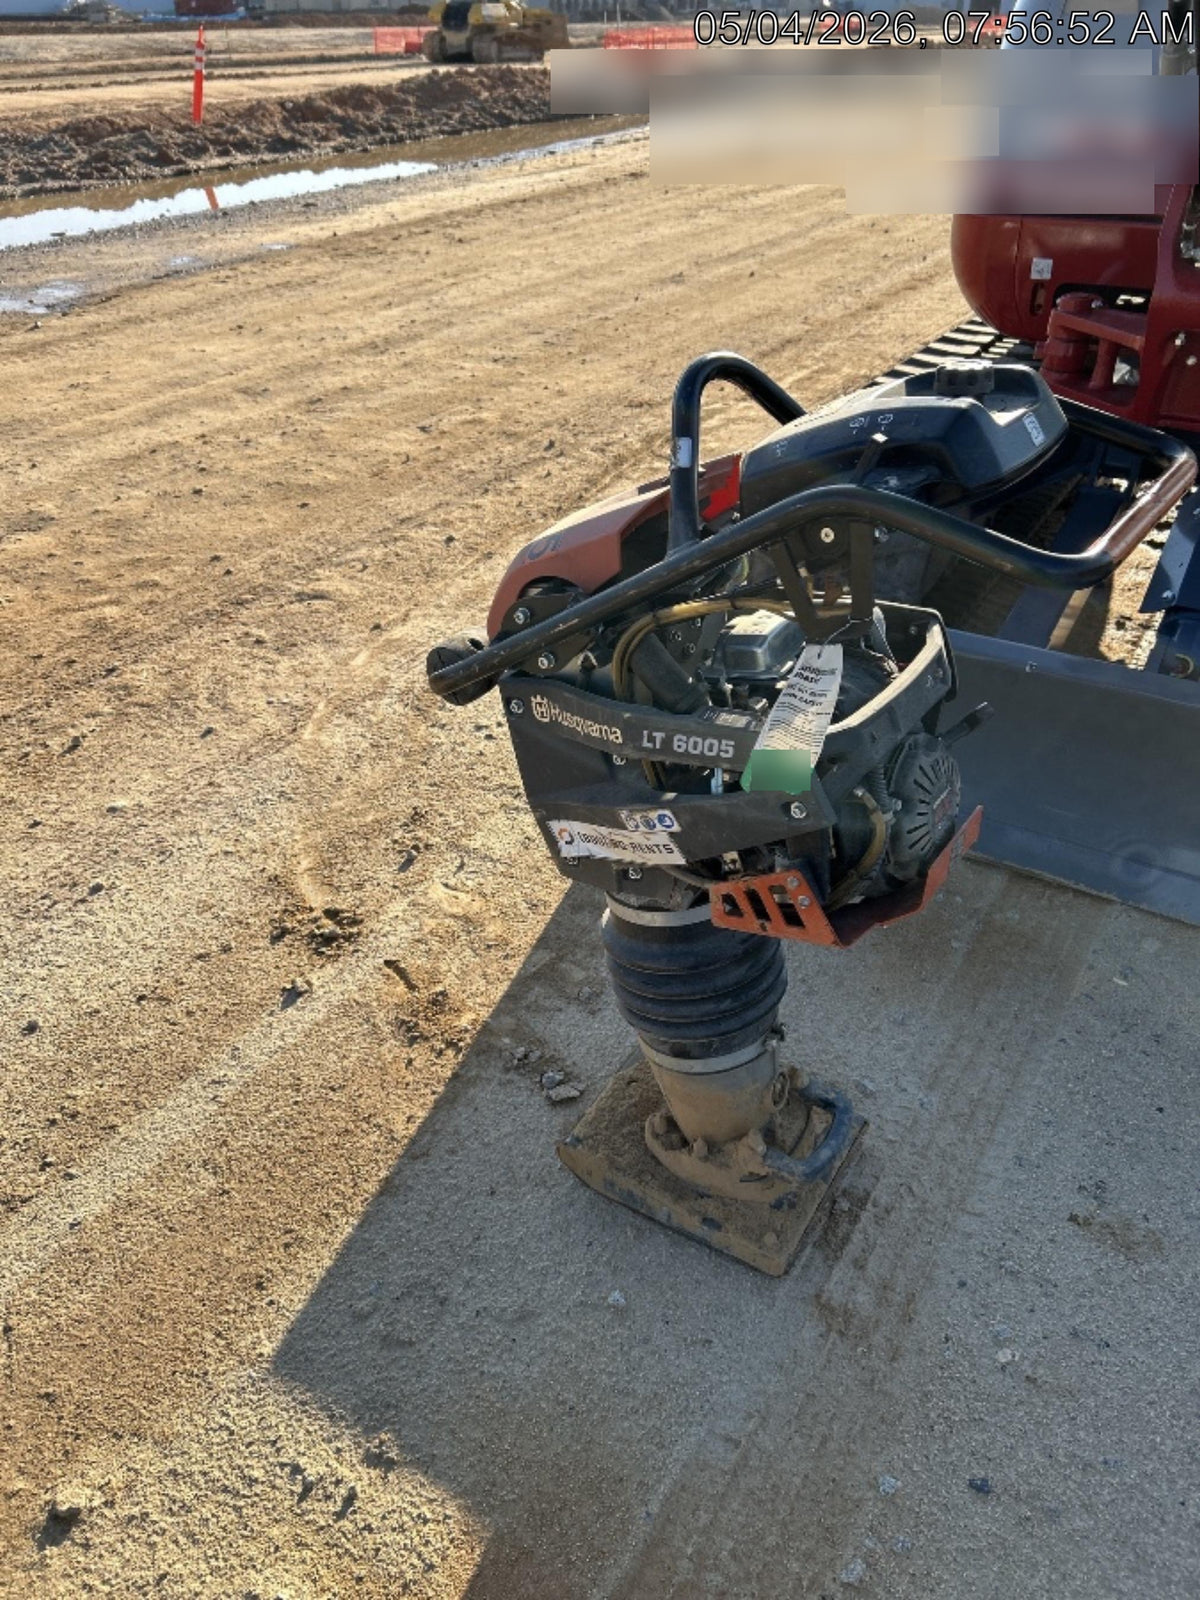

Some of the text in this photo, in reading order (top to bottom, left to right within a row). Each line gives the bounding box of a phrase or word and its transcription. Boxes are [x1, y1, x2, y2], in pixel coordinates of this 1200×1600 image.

[550, 705, 623, 744] Husqvarna
[642, 730, 735, 758] LT 6005
